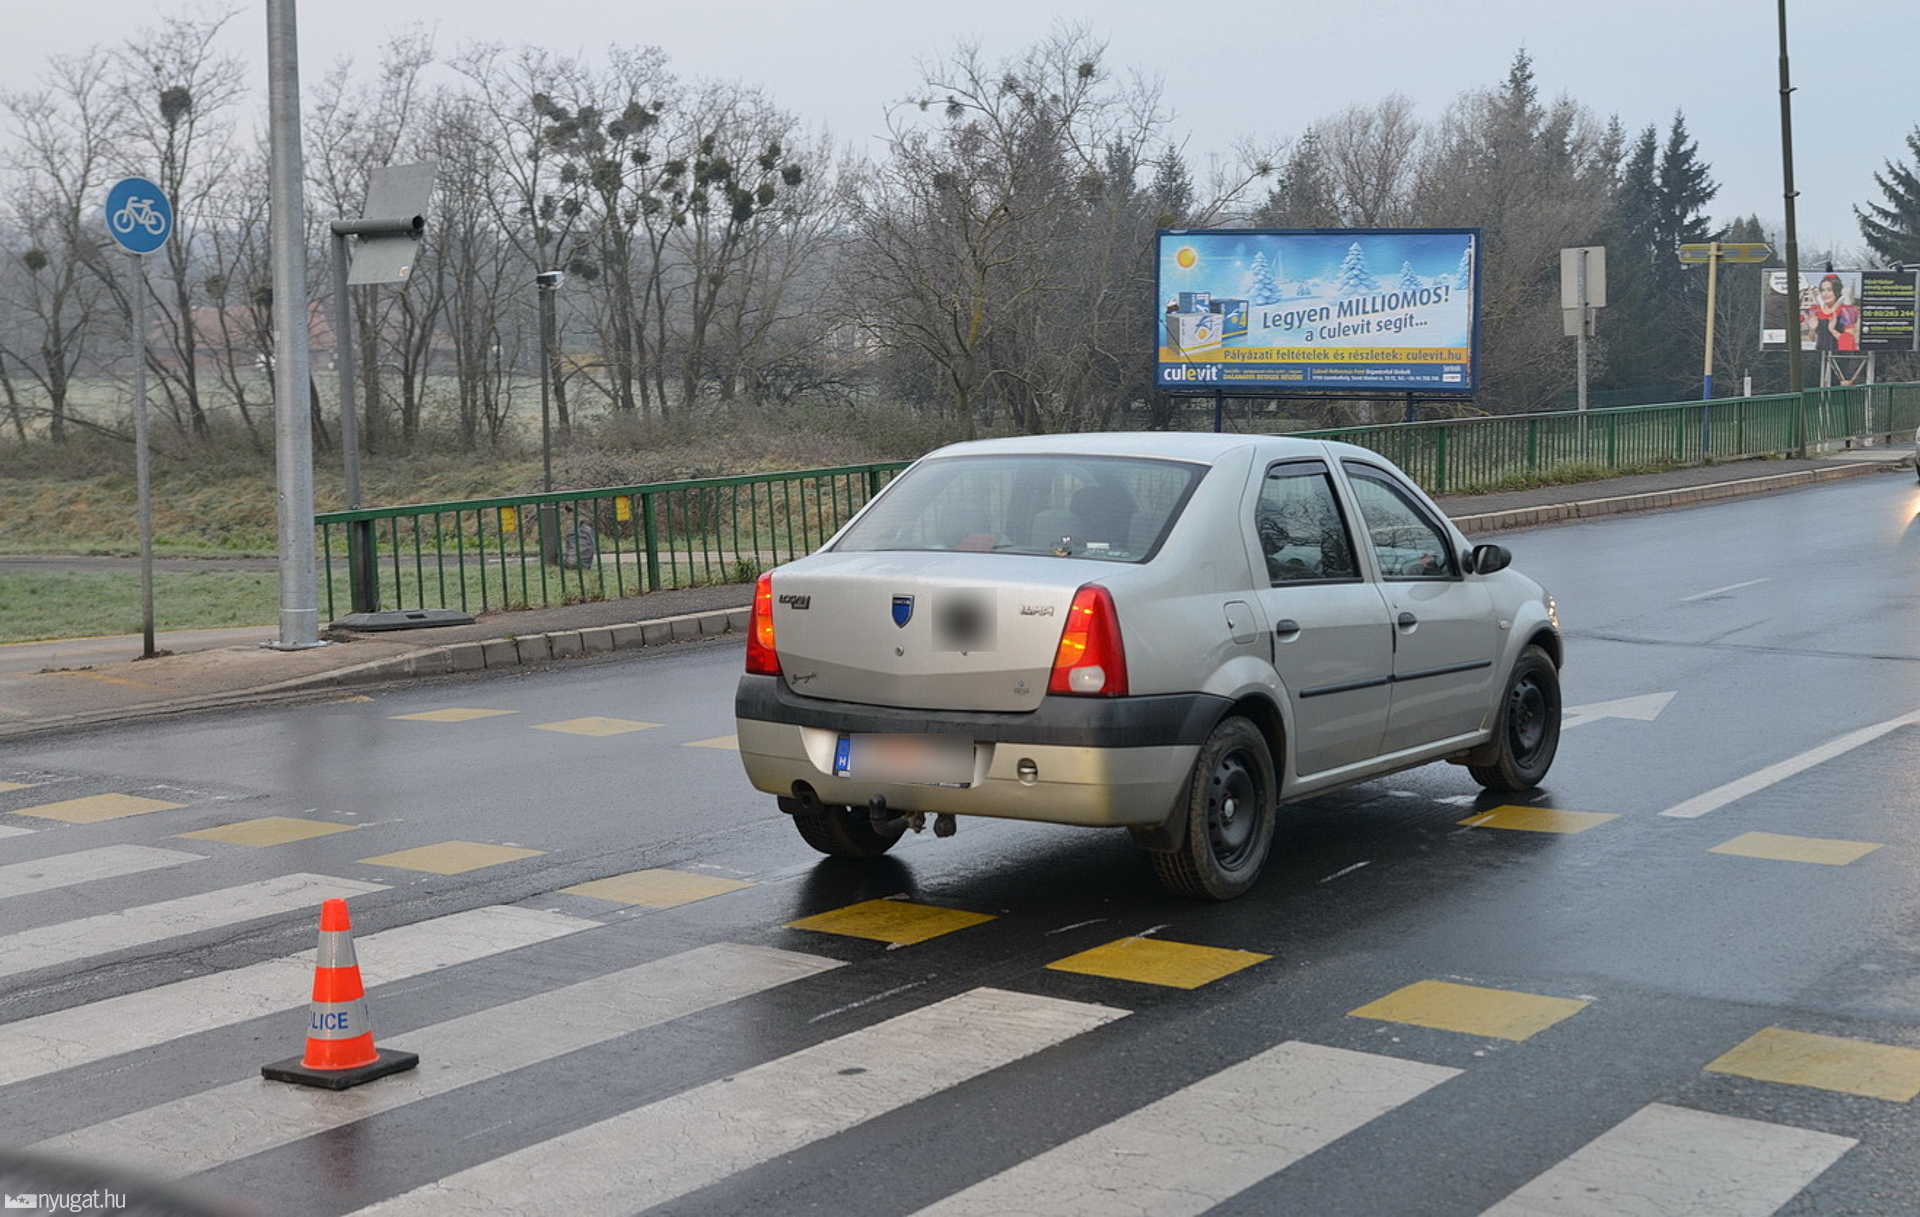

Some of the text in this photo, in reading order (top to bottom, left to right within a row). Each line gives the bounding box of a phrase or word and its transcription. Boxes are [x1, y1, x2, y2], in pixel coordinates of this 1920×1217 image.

[1263, 285, 1450, 331] Legyen MILLIOMOS!
[1305, 330, 1314, 342] a
[1319, 319, 1371, 340] Culevit
[1333, 348, 1345, 360] és
[1406, 348, 1462, 360] culevit.hu
[839, 755, 847, 766] H
[309, 1011, 349, 1031] LICE
